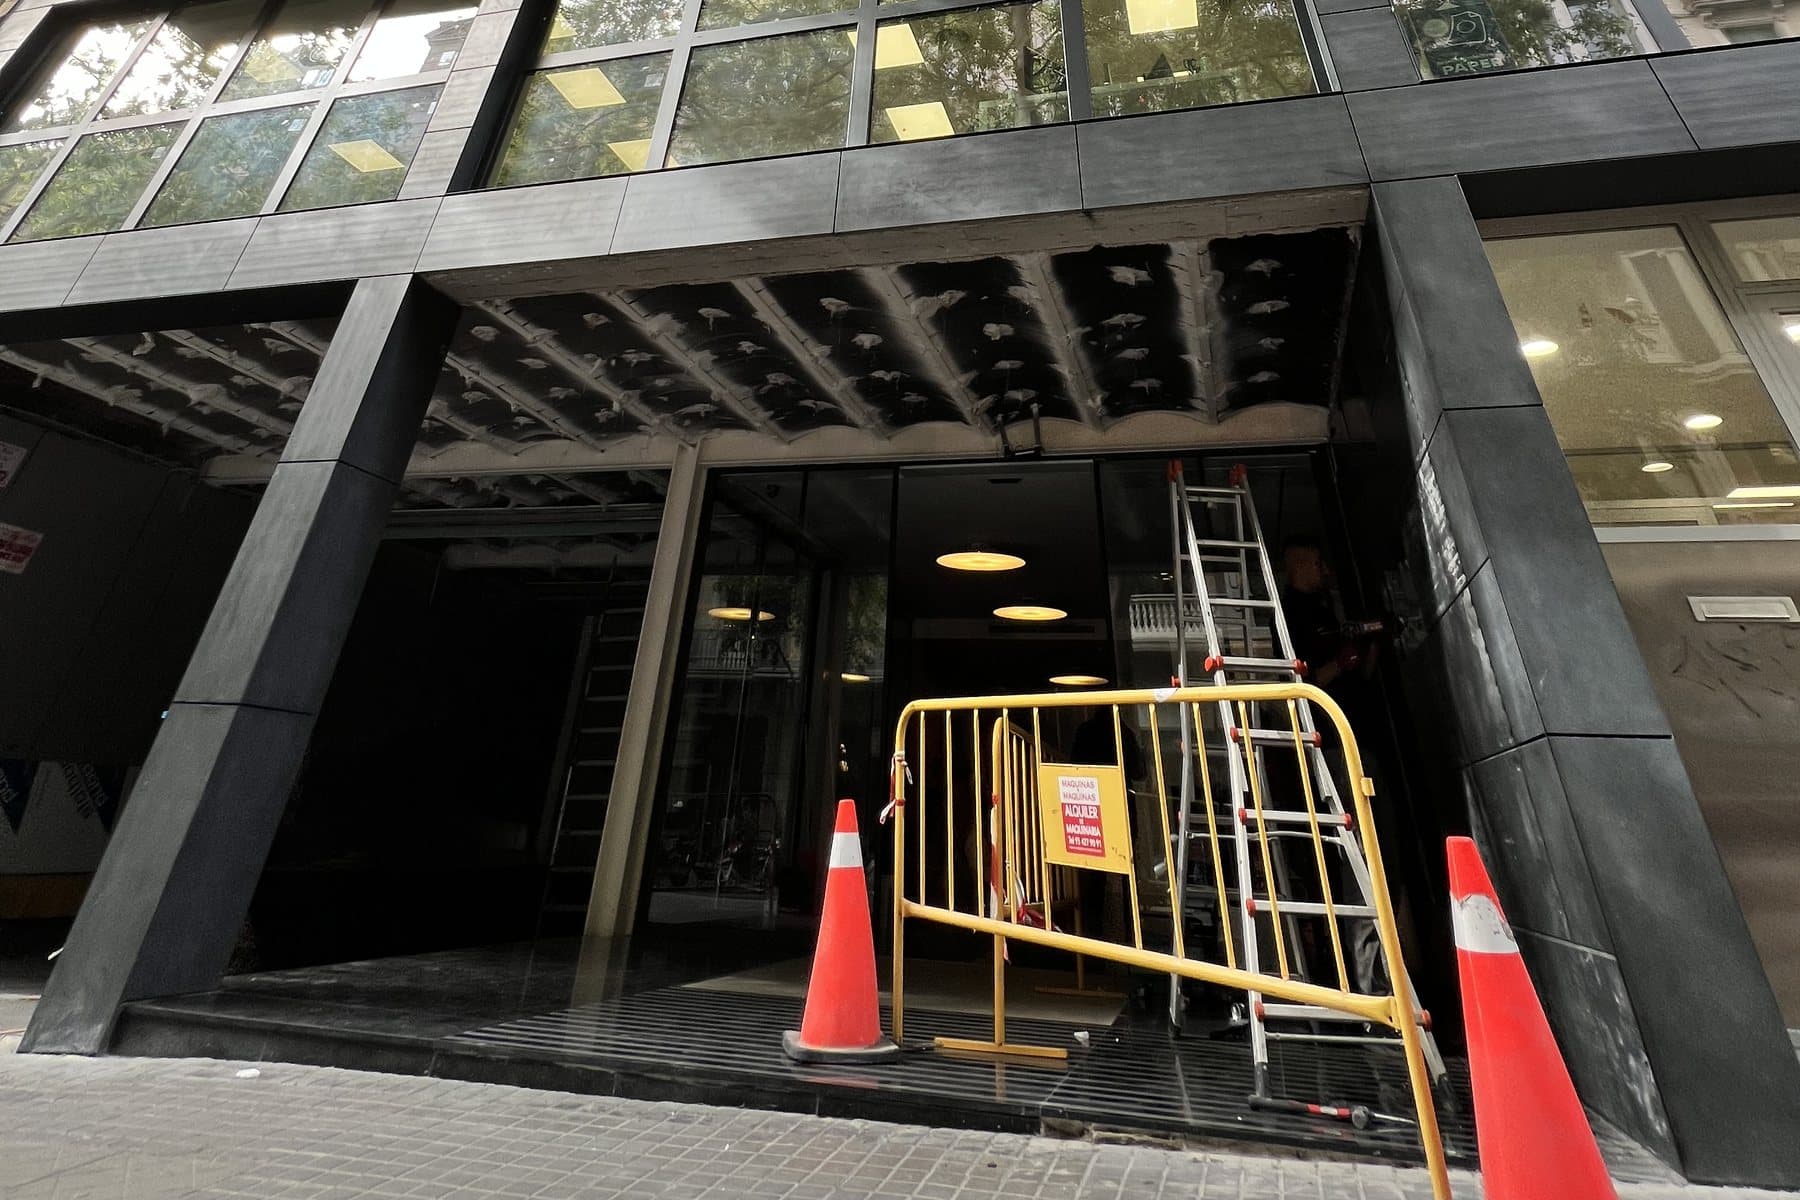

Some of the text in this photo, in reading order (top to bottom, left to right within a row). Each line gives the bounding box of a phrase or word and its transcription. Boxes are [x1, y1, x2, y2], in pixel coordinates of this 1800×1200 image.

[1061, 779, 1095, 789] MAQUINAS
[1063, 792, 1097, 802] MAQUINAS
[1065, 804, 1098, 819] ALQUILER
